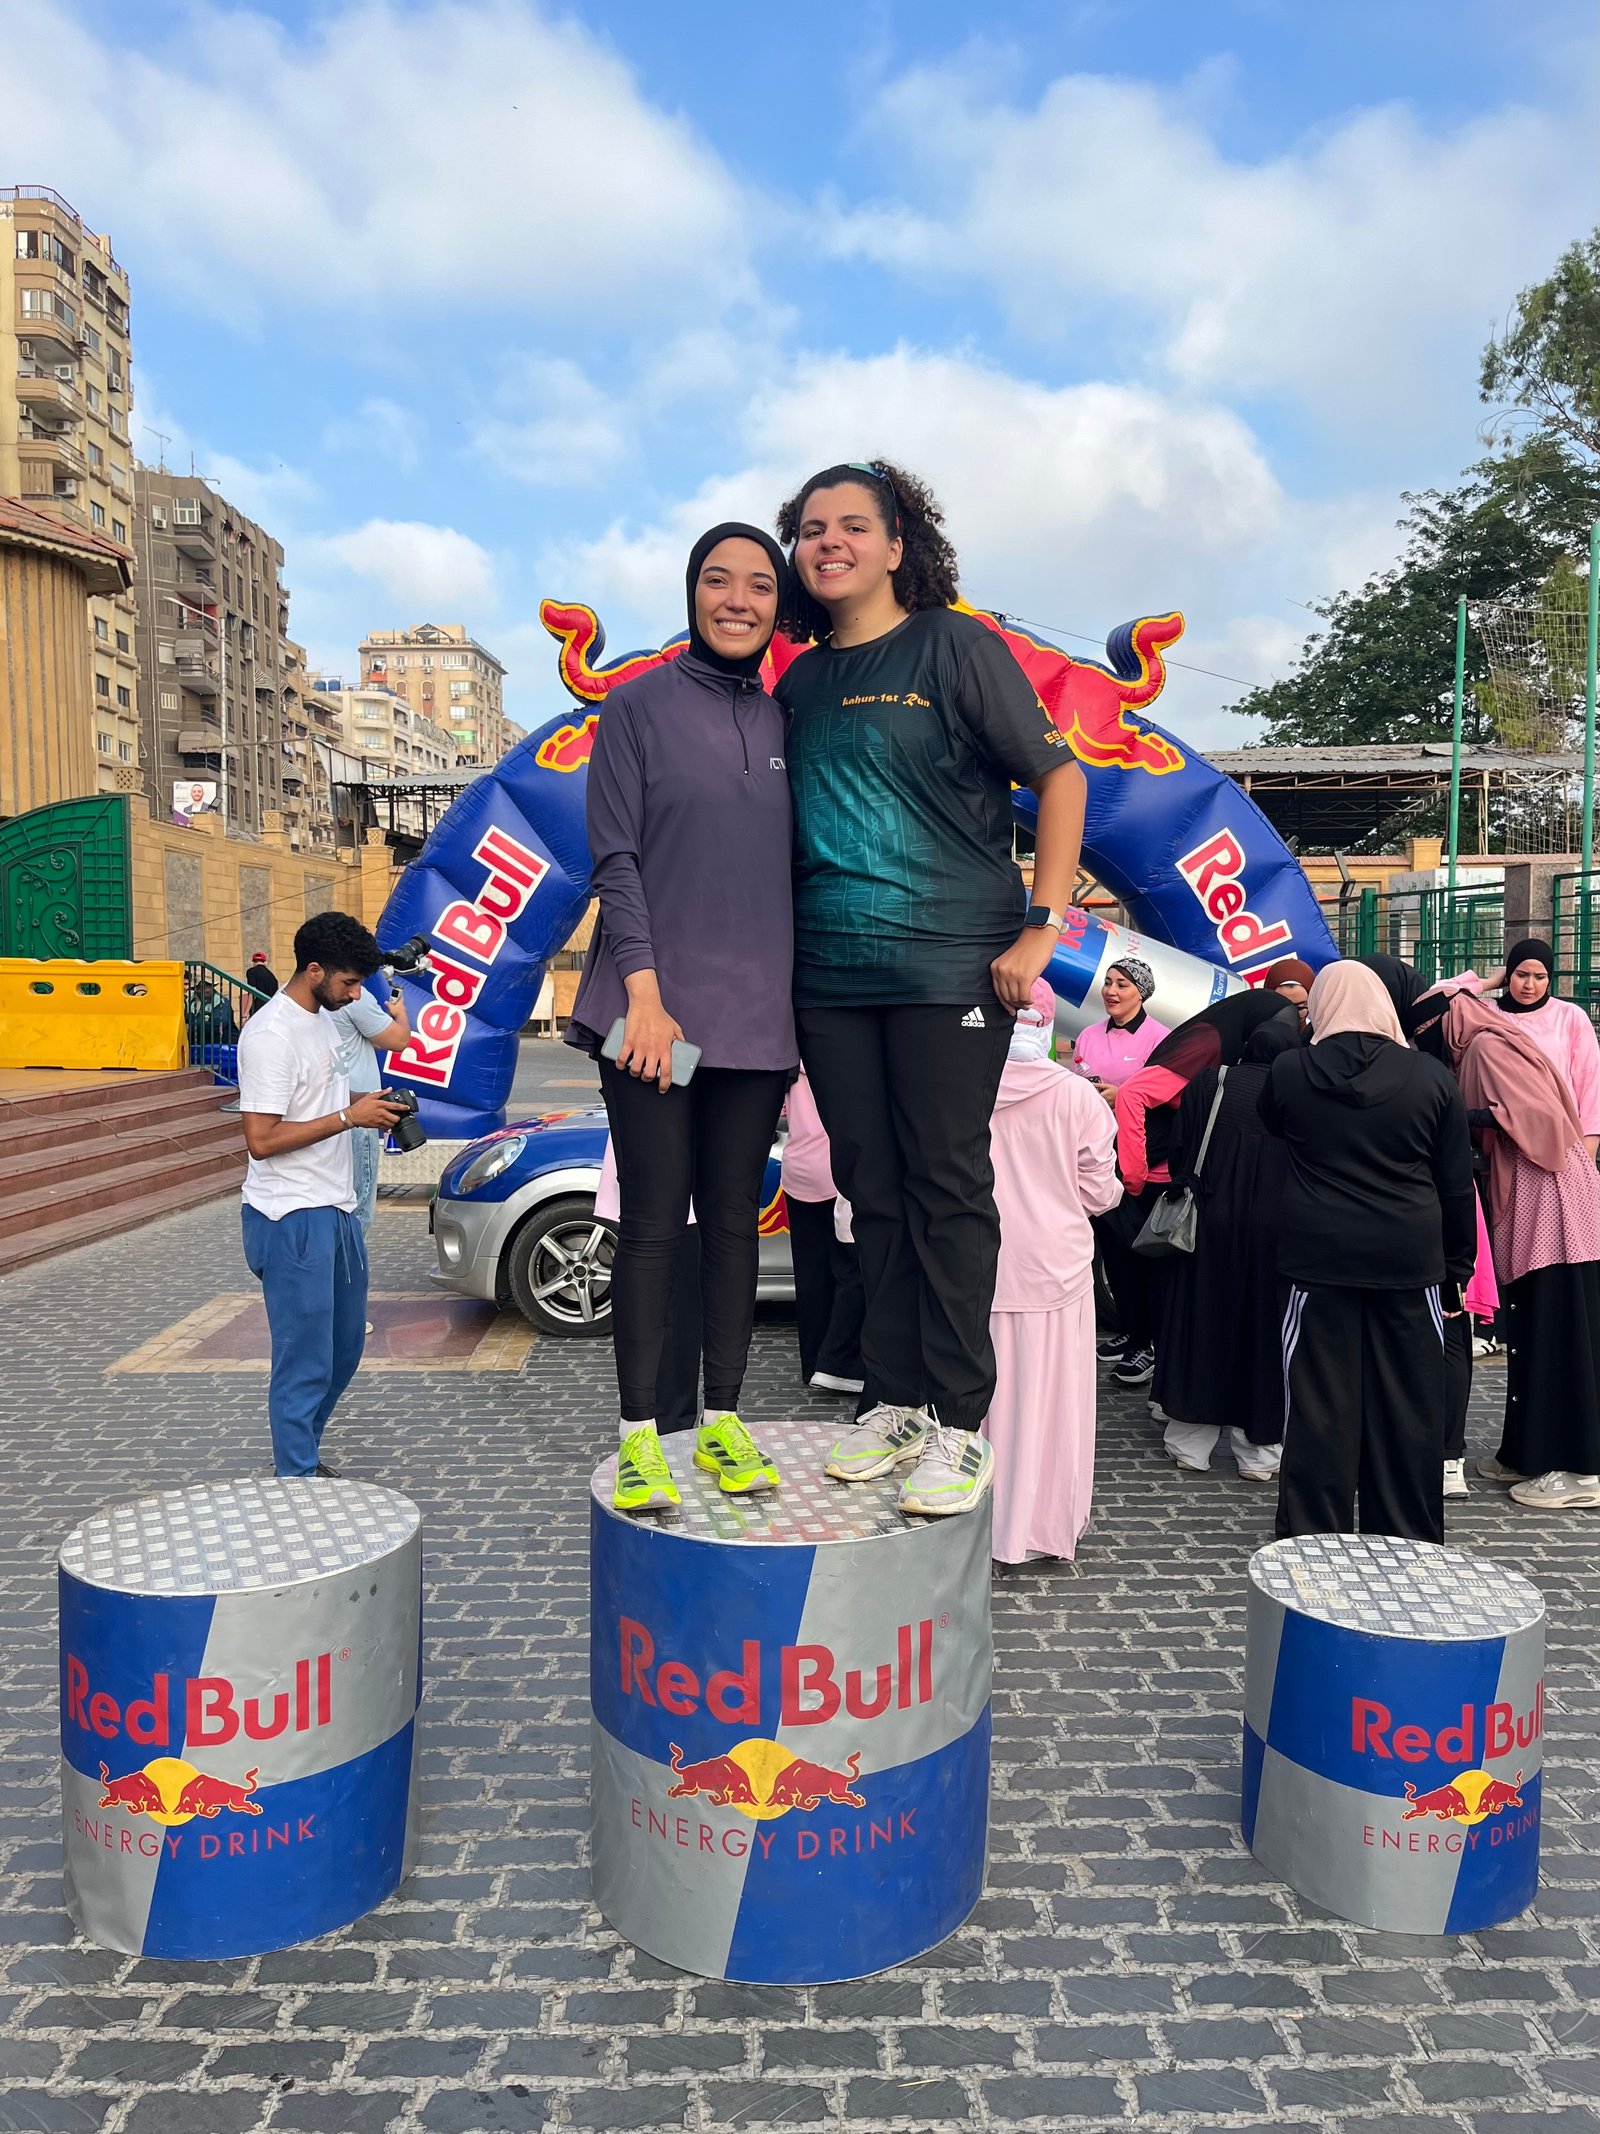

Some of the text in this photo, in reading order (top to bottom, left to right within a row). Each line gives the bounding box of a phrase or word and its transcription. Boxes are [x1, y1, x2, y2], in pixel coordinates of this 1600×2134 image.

[902, 692, 930, 708] Run
[1180, 832, 1288, 959] Red
[388, 830, 545, 1084] Red Bull
[961, 1019, 986, 1028] adidas
[67, 1652, 169, 1747] Red
[186, 1652, 332, 1748] Bull
[619, 1614, 760, 1726] Red
[781, 1618, 934, 1727] Bull
[1351, 1676, 1544, 1763] Red Bull
[75, 1808, 316, 1859] ENERGY DRINK
[632, 1797, 917, 1860] ENERGY DRINK
[1362, 1824, 1481, 1854] ENERGY
